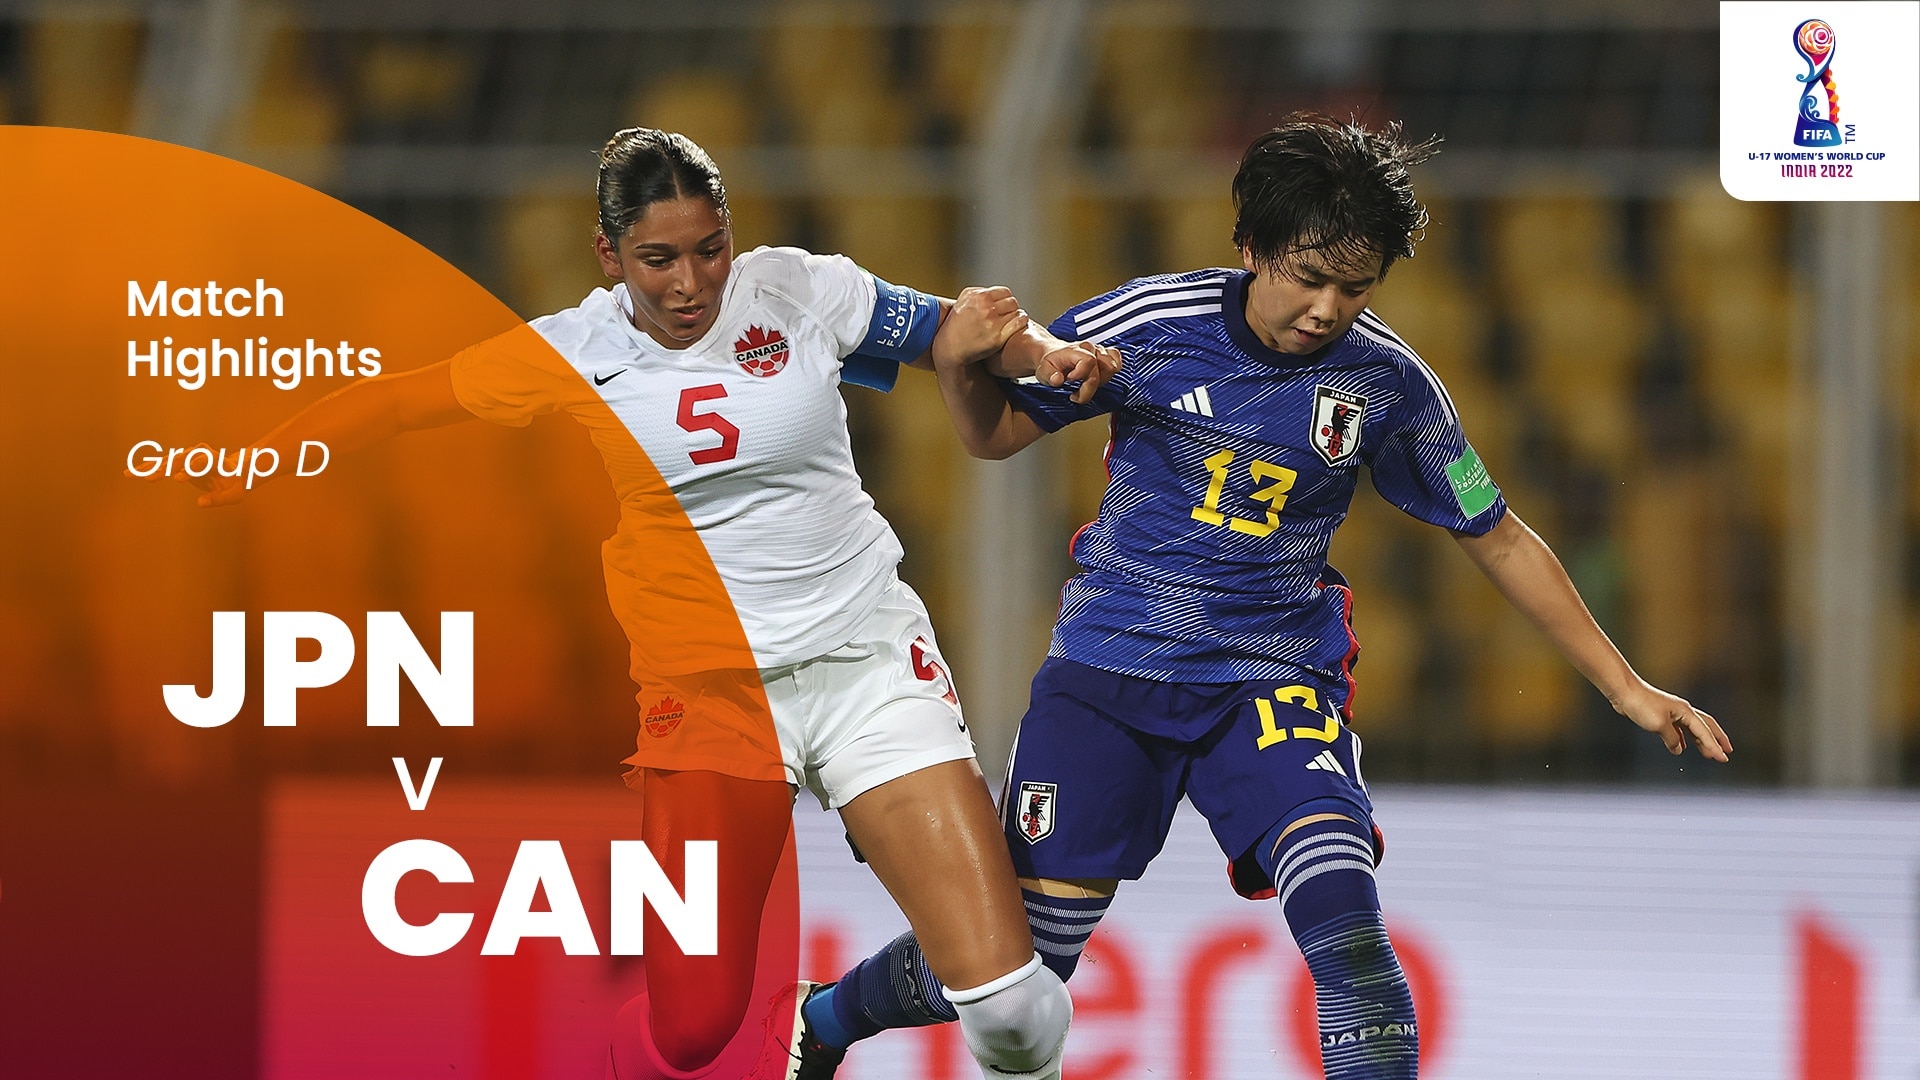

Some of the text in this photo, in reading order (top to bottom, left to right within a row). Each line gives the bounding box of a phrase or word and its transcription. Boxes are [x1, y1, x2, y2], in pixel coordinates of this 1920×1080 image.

[736, 341, 789, 363] CANADA
[1330, 390, 1357, 403] JAPAN
[676, 383, 741, 466] 5
[1191, 448, 1297, 538] 13
[910, 635, 958, 706] 5
[645, 712, 683, 724] CANADA
[1254, 685, 1340, 751] 13
[1323, 1023, 1416, 1047] JAPAN
